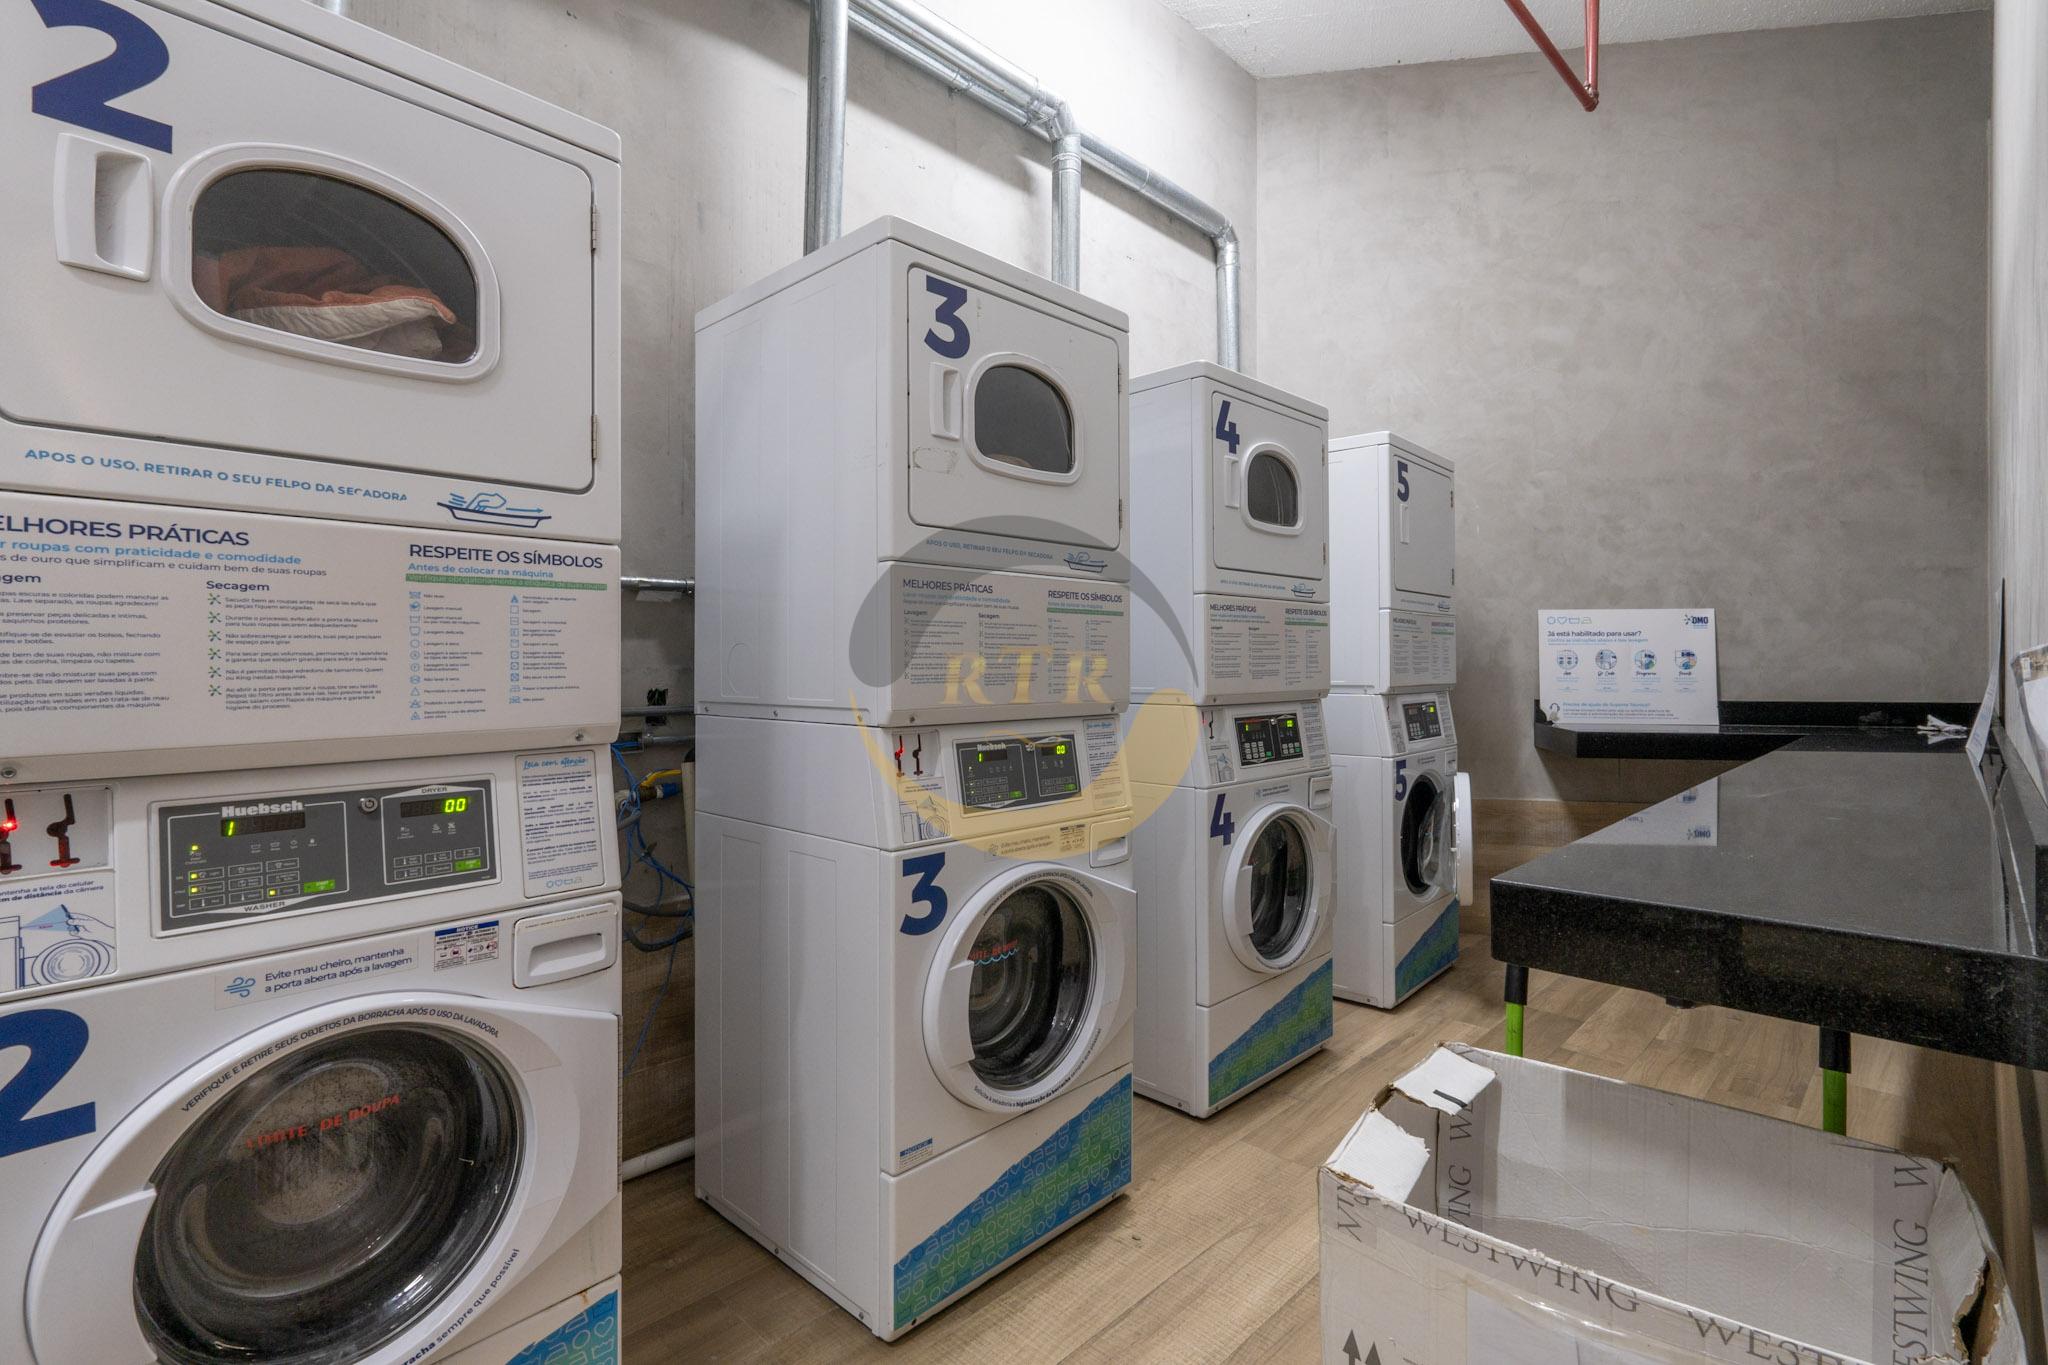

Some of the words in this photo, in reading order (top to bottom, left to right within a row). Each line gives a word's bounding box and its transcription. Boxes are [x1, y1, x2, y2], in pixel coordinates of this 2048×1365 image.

[32, 0, 173, 154] 2
[924, 274, 971, 359] 3
[1215, 400, 1240, 454] 4
[25, 449, 76, 464] APOS
[81, 456, 94, 466] O
[144, 462, 213, 480] RETIRAR
[217, 471, 229, 481] O
[232, 474, 261, 485] SEU
[266, 477, 311, 490] FELPO
[315, 483, 335, 494] DA
[338, 486, 408, 502] SECADORA
[1396, 460, 1410, 502] 5
[129, 523, 249, 546] PRÁTICAS
[12, 542, 70, 553] roupas
[75, 545, 110, 554] com
[115, 547, 201, 560] praticidade
[205, 552, 213, 560] e
[217, 553, 302, 565] comodidade
[409, 544, 493, 562] RESPEITE
[496, 550, 520, 564] OS
[523, 550, 604, 569] SÍMBOLOS
[10, 554, 28, 562] de
[31, 556, 62, 564] ouro
[65, 557, 91, 566] que
[94, 558, 166, 568] simplificam
[178, 562, 221, 571] cuidam
[224, 564, 249, 573] bem
[251, 566, 265, 574] de
[293, 568, 327, 577] roupas
[408, 563, 439, 573] Antes
[442, 564, 456, 573] de
[458, 566, 495, 576] colocar
[498, 568, 510, 576] na
[512, 568, 554, 579] máquina
[0, 574, 41, 584] gem
[206, 580, 270, 592] Secagem
[903, 579, 952, 592] MELHORES
[953, 581, 993, 594] PRÁTICAS
[1048, 590, 1080, 601] RESPEITE
[1080, 592, 1090, 601] OS
[1090, 592, 1123, 604] SÍMBOLOS
[903, 609, 929, 617] Lavagem
[978, 612, 1000, 620] Secagem
[1691, 616, 1709, 625] OMO
[1547, 630, 1555, 638] Já
[1556, 630, 1570, 638] está
[1571, 630, 1605, 638] habilitado
[1623, 630, 1642, 638] usar?
[421, 786, 448, 794] DRYER
[1394, 760, 1408, 802] 5
[221, 800, 304, 818] Huebsch
[444, 798, 467, 813] 00
[1210, 793, 1235, 846] 4
[24, 890, 62, 900] distância
[75, 885, 104, 893] câmera
[69, 880, 94, 888] celular
[900, 851, 949, 936] 3
[244, 900, 286, 913] WASHER
[264, 985, 272, 993] a
[273, 978, 302, 993] porta
[304, 972, 337, 985] aberta
[339, 966, 363, 979] após
[372, 956, 413, 972] lavagem
[265, 969, 291, 982] Evite
[293, 965, 318, 976] mau
[319, 957, 353, 970] cheiro,
[354, 947, 405, 963] mantenha
[181, 1071, 233, 1113] VERIFIQUE
[233, 1066, 241, 1075] E
[240, 1047, 274, 1070] RETIRE
[275, 1034, 299, 1051] SEUS
[300, 1019, 342, 1040] OBJETOS
[343, 1016, 356, 1026] DA
[357, 1008, 405, 1023] BORRACHA
[406, 1006, 429, 1016] APÓS
[429, 1008, 435, 1016] O
[436, 1009, 453, 1018] USO
[452, 1012, 464, 1021] DA
[464, 1016, 499, 1039] LAVADORA
[0, 1008, 96, 1158] 2
[320, 1114, 343, 1131] DE
[436, 1307, 474, 1343] sempre
[473, 1288, 491, 1308] que
[490, 1248, 520, 1288] possível
